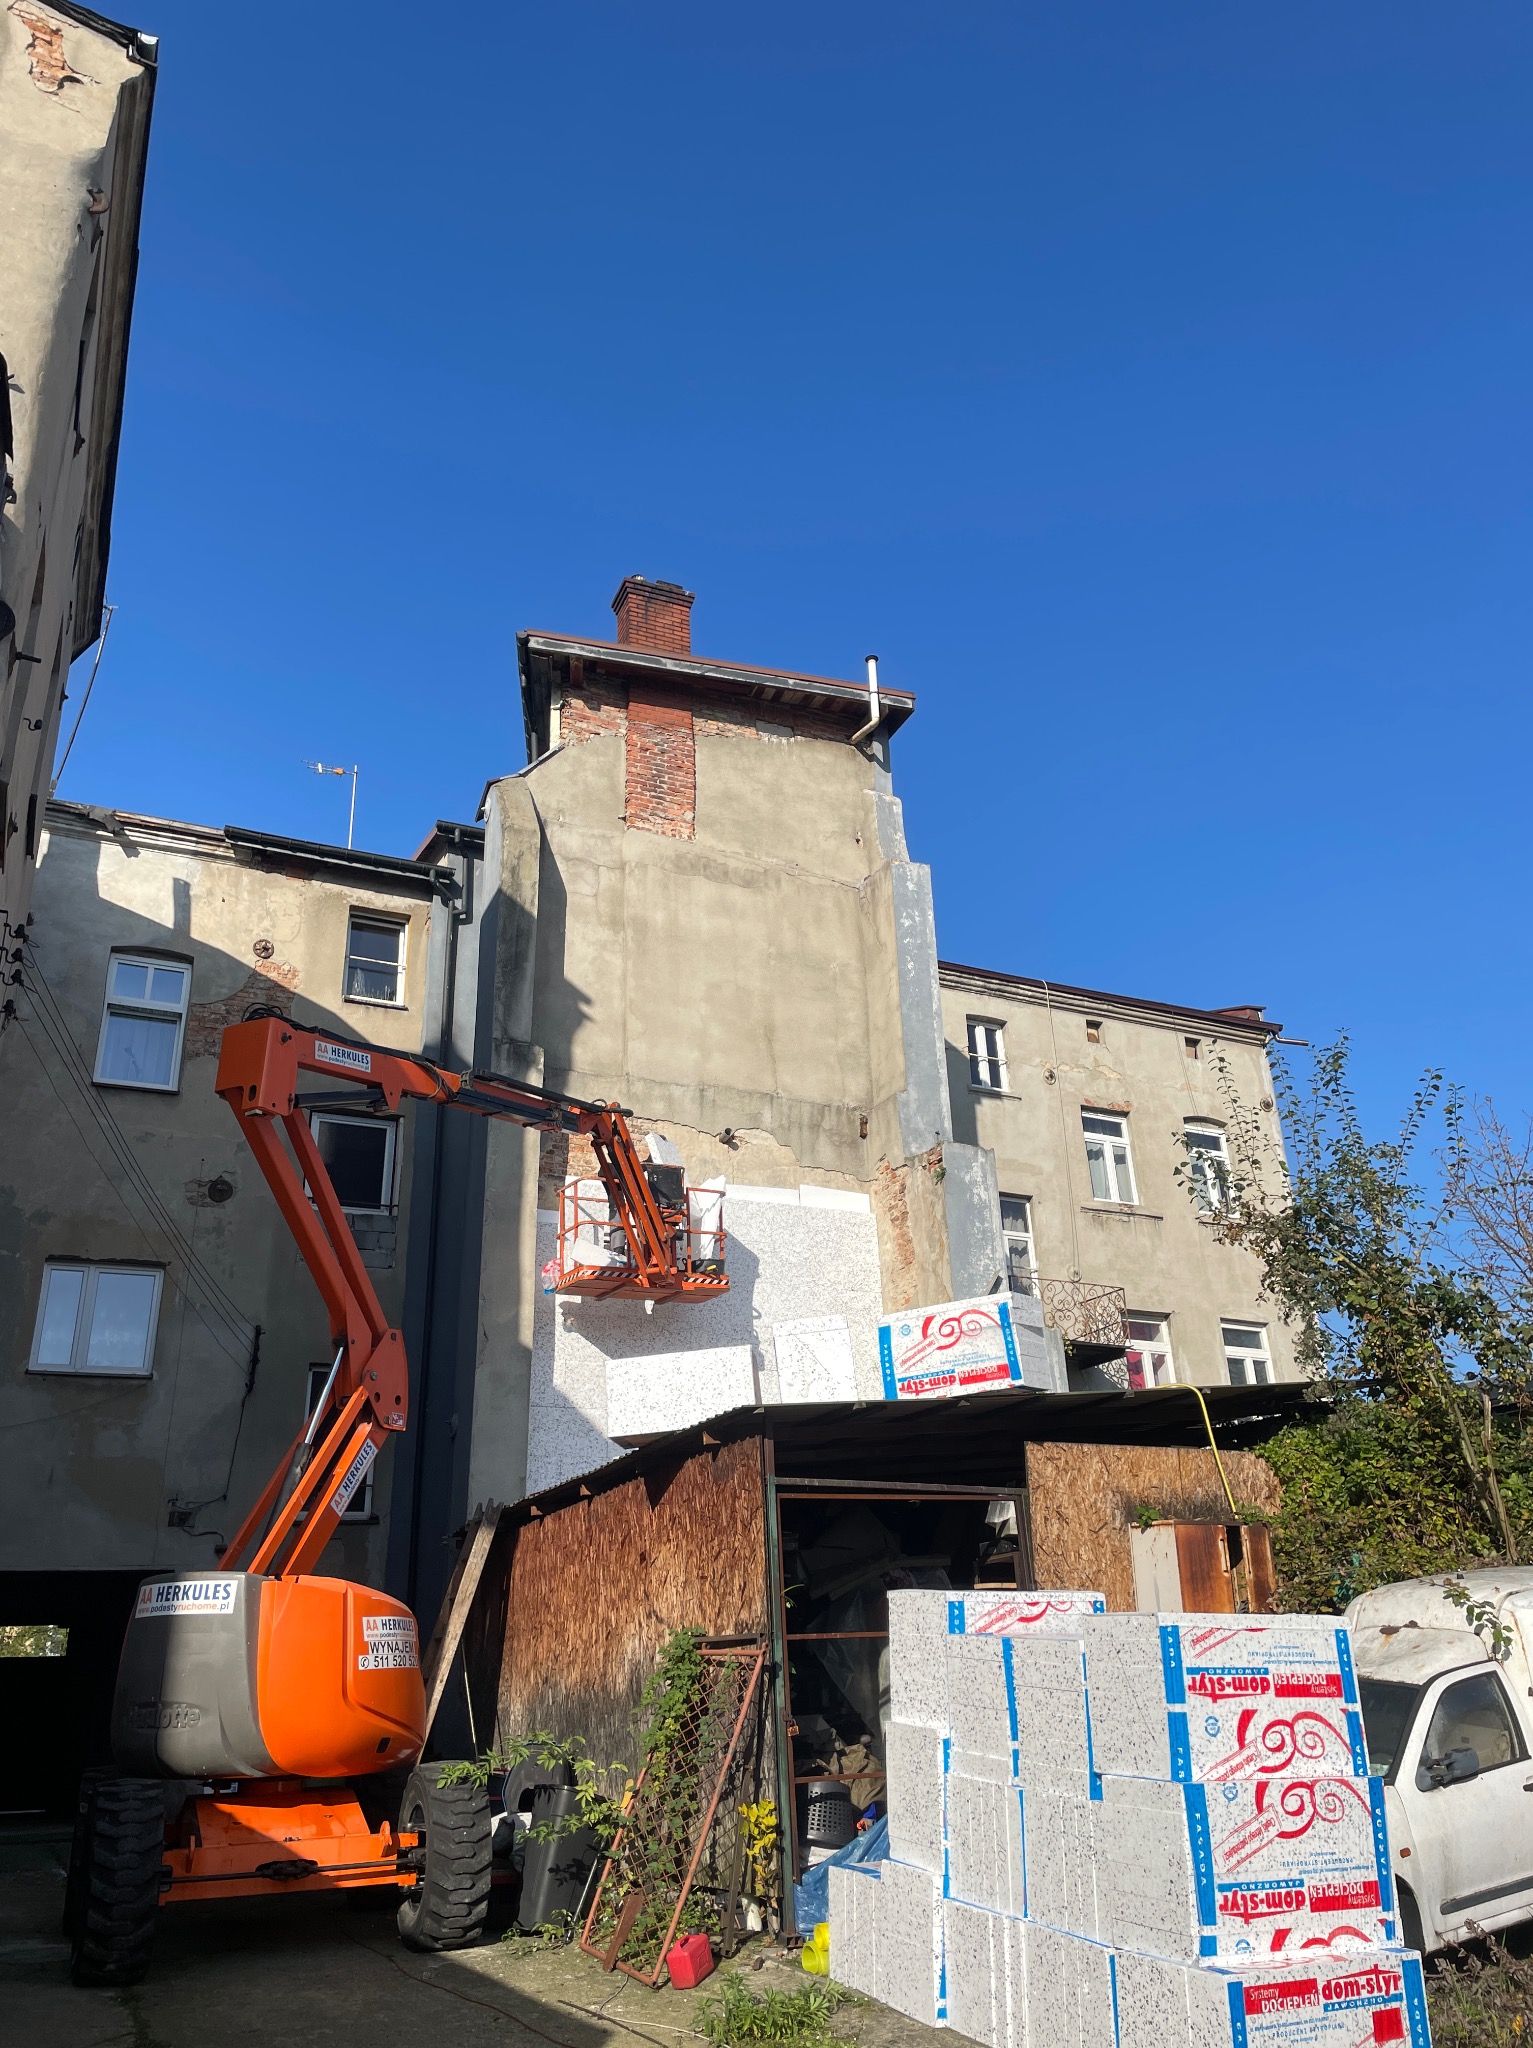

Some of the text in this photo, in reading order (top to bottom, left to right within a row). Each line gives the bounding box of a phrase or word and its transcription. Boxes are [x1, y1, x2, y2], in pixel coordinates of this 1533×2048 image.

[317, 1044, 369, 1065] AA HERKULES
[899, 1375, 957, 1396] dom-styr
[334, 1492, 345, 1509] AA
[342, 1441, 373, 1493] HERKULES
[140, 1583, 232, 1604] AA HERKULES
[366, 1619, 379, 1631] AA
[374, 1655, 389, 1668] 511
[393, 1655, 407, 1667] 520
[1188, 1672, 1271, 1704] dom-styr
[1274, 1673, 1327, 1689] DOCIEPLEŃ
[1311, 1684, 1338, 1696] Systemy
[1195, 1813, 1207, 1886] FASADA
[1375, 1807, 1388, 1875] FASADA
[1242, 1880, 1300, 1890] JAWORZNO
[1310, 1883, 1364, 1903] DOCIEPLEŃ
[1219, 1889, 1306, 1925] dom-styr
[1348, 1893, 1376, 1906] Systemy
[1322, 1964, 1402, 1997] dom-styr
[1250, 1987, 1279, 2001] Systemy
[1262, 1990, 1318, 2013] DOCIEPLEŃ
[1327, 1997, 1383, 2011] JAWORZNO
